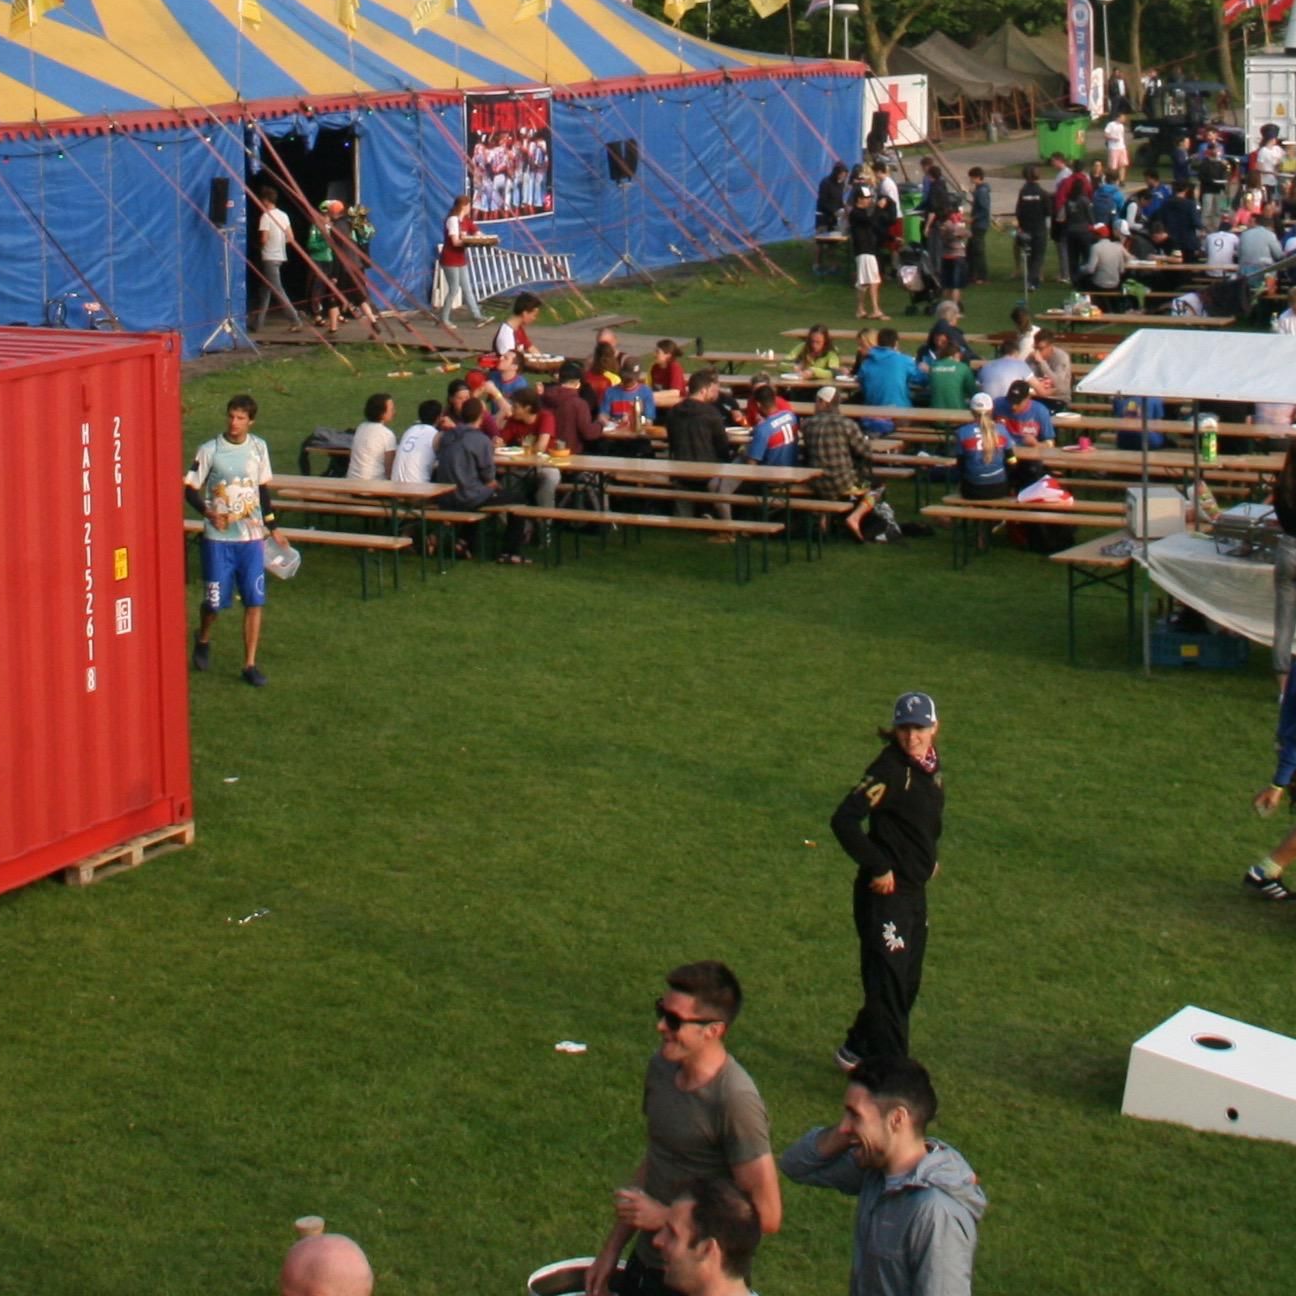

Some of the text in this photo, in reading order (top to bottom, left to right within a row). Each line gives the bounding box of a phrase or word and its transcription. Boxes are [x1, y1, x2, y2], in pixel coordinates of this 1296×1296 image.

[113, 416, 121, 507] 22G1
[402, 436, 418, 453] 5
[81, 423, 95, 691] HAKU 215261 8
